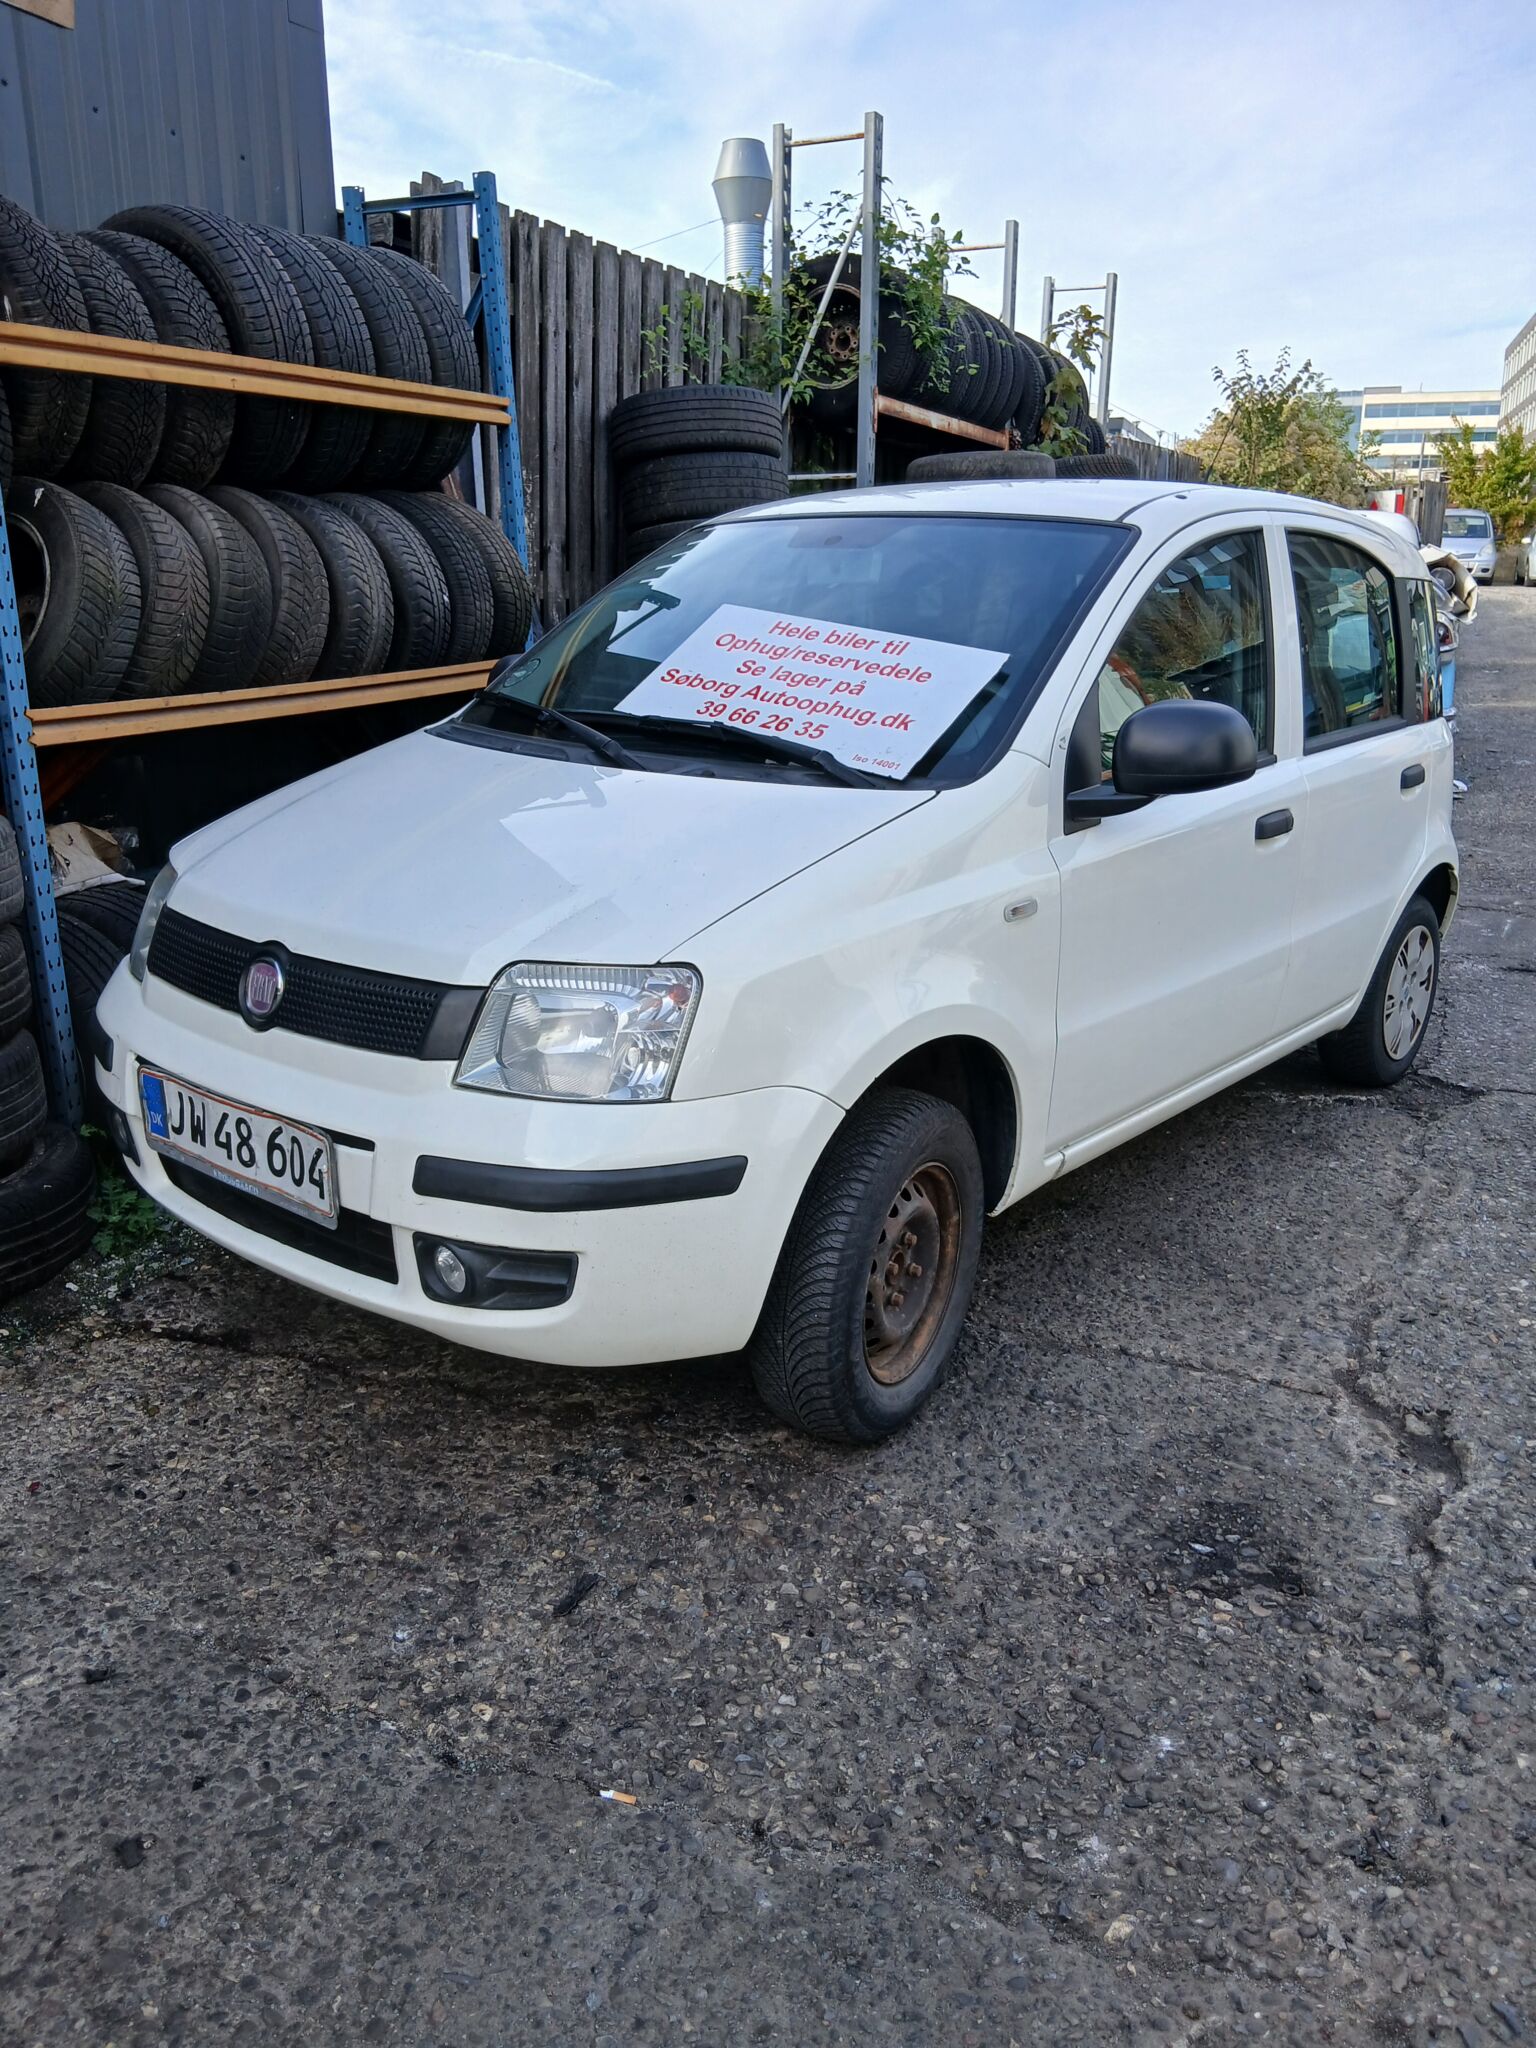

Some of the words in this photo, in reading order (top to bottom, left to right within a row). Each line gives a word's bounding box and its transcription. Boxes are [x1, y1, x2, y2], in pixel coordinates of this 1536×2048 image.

[768, 621, 820, 641] Hele
[822, 629, 880, 652] biler
[881, 640, 908, 656] til
[715, 633, 932, 683] Ophug/reservedele
[736, 660, 767, 677] Se
[769, 665, 832, 688] lager
[829, 680, 867, 696] på
[660, 668, 741, 698] Søborg
[740, 685, 916, 732] Autoophug.dk
[696, 700, 728, 717] 39
[728, 707, 760, 725] 66
[758, 714, 794, 732] 26
[794, 721, 829, 739] 35
[851, 753, 869, 764] Iso
[871, 758, 901, 771] 14001
[252, 972, 276, 1004] FIAT
[150, 1110, 164, 1128] DK
[170, 1091, 206, 1147] JW
[213, 1111, 257, 1169] 48
[266, 1125, 326, 1200] 604
